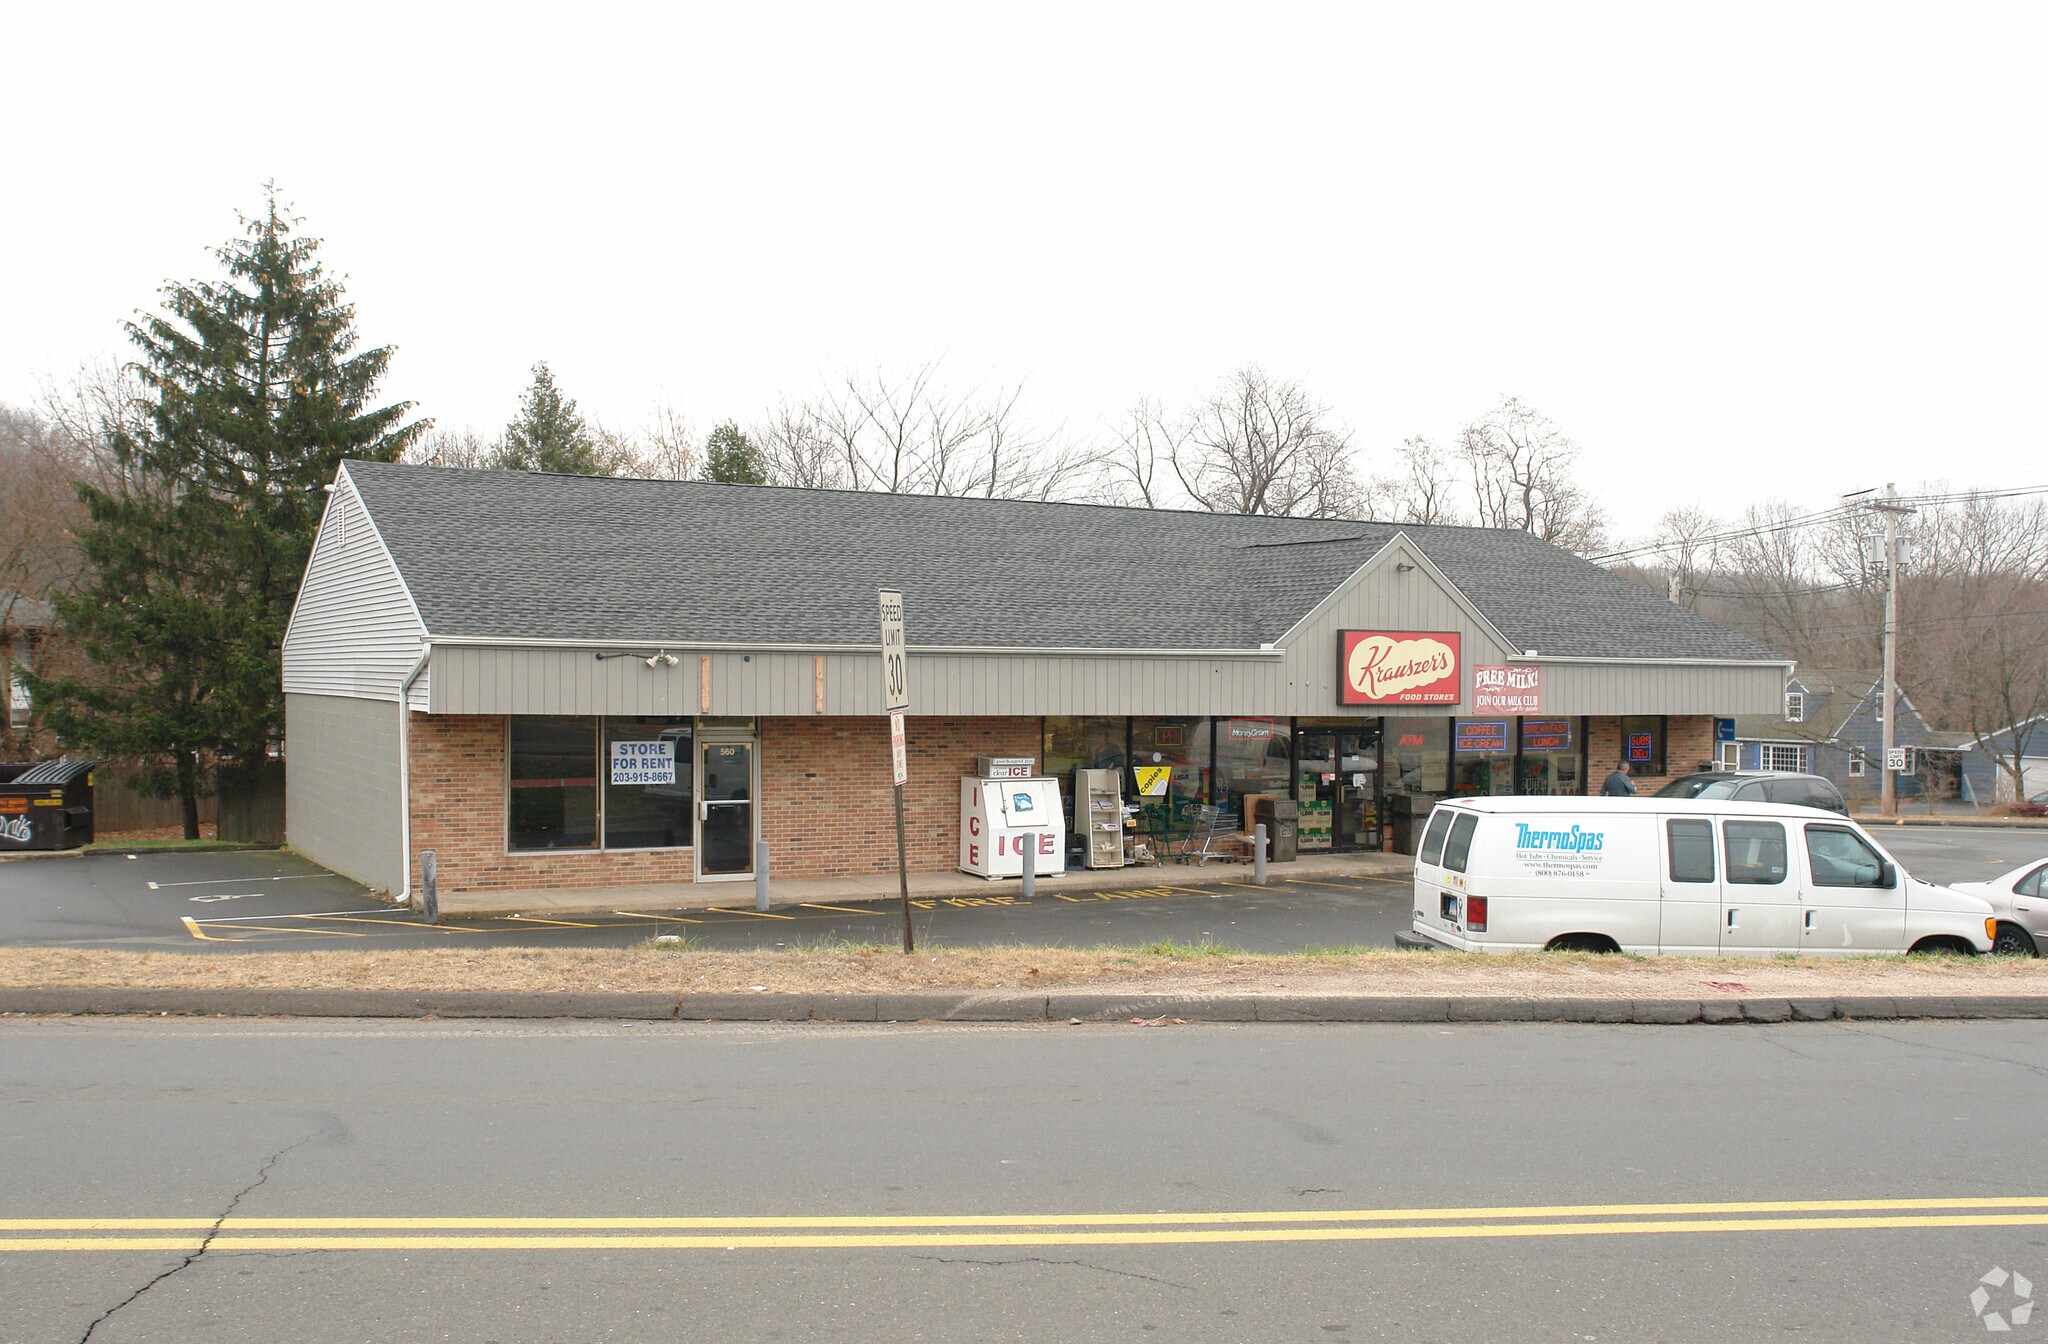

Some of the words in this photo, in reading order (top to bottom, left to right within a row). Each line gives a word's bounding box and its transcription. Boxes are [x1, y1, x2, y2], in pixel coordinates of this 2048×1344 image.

[881, 603, 902, 621] SPEED
[885, 629, 901, 646] LIMIT
[888, 653, 903, 696] 30
[1358, 645, 1449, 697] Krauszer's
[1475, 669, 1506, 689] FREE
[1506, 669, 1538, 689] MILK!
[1399, 693, 1422, 701] FOOD
[1423, 693, 1455, 701] STORES
[1476, 695, 1491, 708] JOIN
[1492, 695, 1507, 706] OUR
[1507, 695, 1523, 706] MILK
[1523, 695, 1538, 706] CLUB
[1231, 728, 1270, 738] MoneyGram
[1465, 725, 1498, 736] COFFEE
[1523, 723, 1568, 735] BREAKFAST
[1398, 734, 1424, 747] ATM
[1459, 739, 1473, 749] ICE
[1474, 739, 1503, 749] CREAM
[1533, 737, 1560, 747] LUNCH
[1631, 735, 1650, 746] SUBS
[619, 743, 667, 756] STORE
[719, 748, 735, 756] 560
[1632, 749, 1649, 759] DELI
[612, 758, 638, 769] FOR
[641, 757, 673, 769] RENT
[1889, 759, 1904, 768] 30
[612, 771, 674, 782] 203-915-8667
[1008, 766, 1028, 776] ICE
[1140, 767, 1163, 794] copies
[969, 787, 980, 866] ICE
[1515, 823, 1604, 853] ThermoSpas
[1523, 862, 1598, 870] www.thermospas.com
